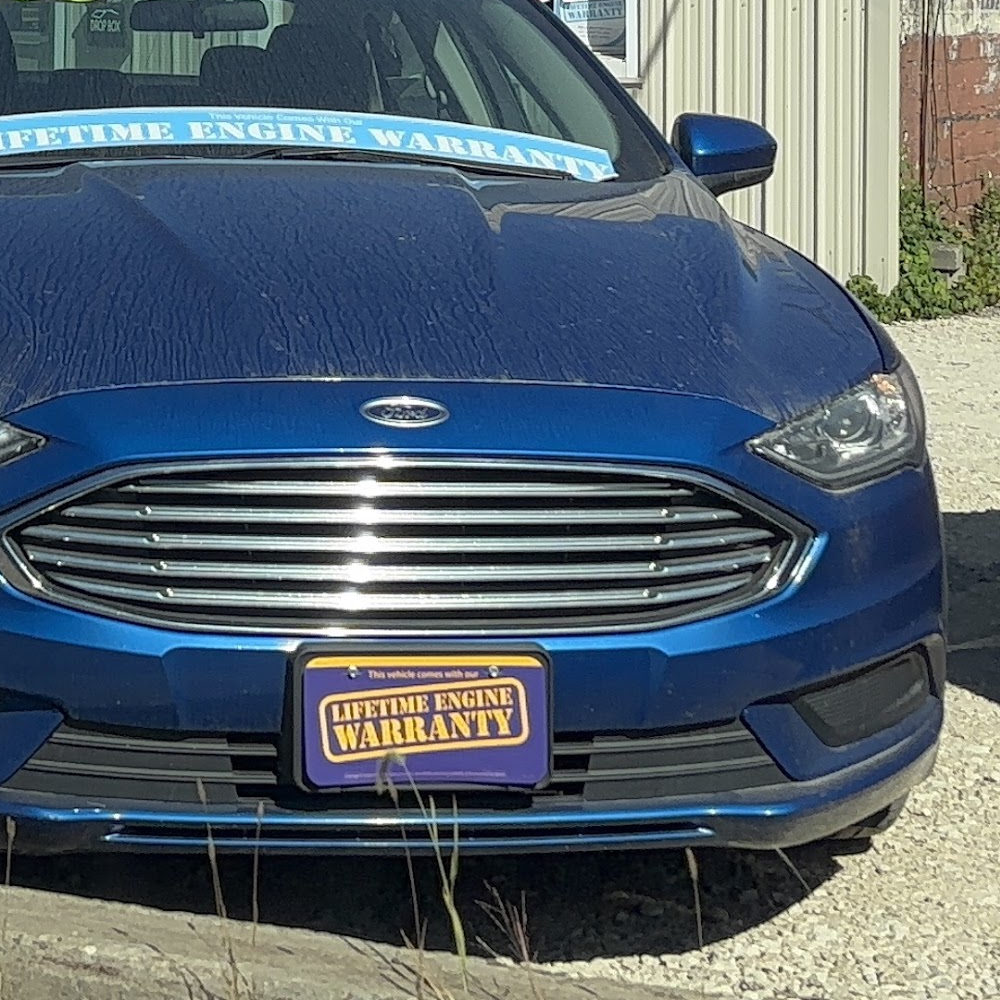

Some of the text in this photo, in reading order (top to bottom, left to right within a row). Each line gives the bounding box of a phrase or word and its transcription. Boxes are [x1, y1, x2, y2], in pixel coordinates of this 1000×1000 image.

[568, 7, 623, 19] WARRANTY
[187, 121, 356, 144] ENGINE
[368, 128, 609, 178] WARRANTY
[368, 669, 385, 679] This
[387, 669, 415, 679] vehicle
[417, 671, 443, 679] comes
[445, 669, 464, 678] with
[331, 686, 514, 722] LIFETIME ENGINE
[333, 708, 514, 752] WARRANTY
